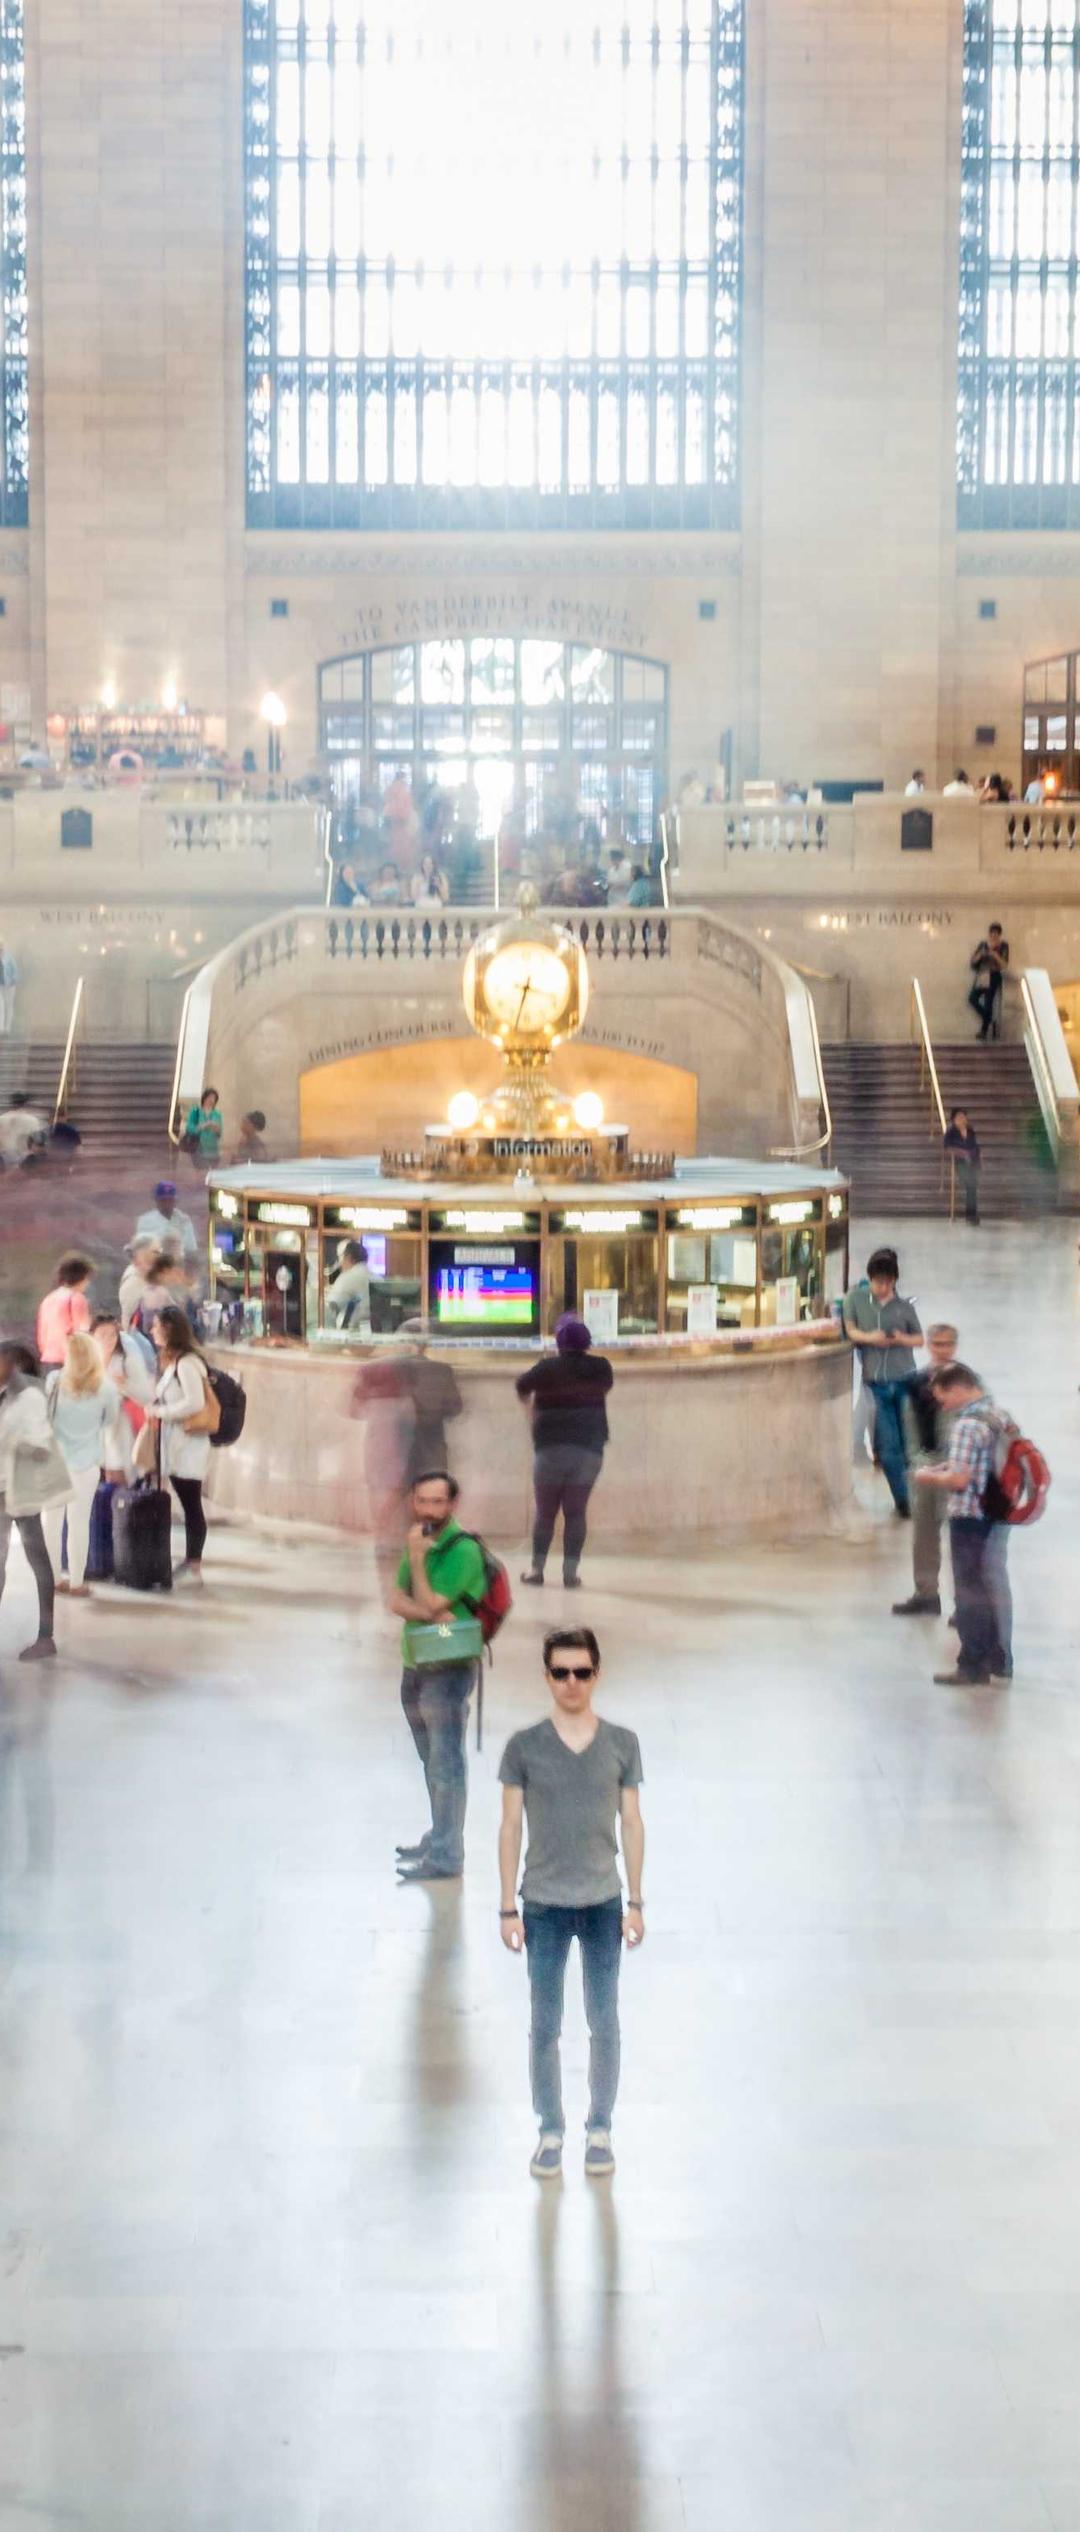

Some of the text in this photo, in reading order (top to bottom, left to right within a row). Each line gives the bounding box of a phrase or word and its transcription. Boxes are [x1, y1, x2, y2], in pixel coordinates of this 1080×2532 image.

[40, 911, 81, 923] WEST
[878, 910, 953, 926] BALCONY
[494, 1137, 593, 1157] Information
